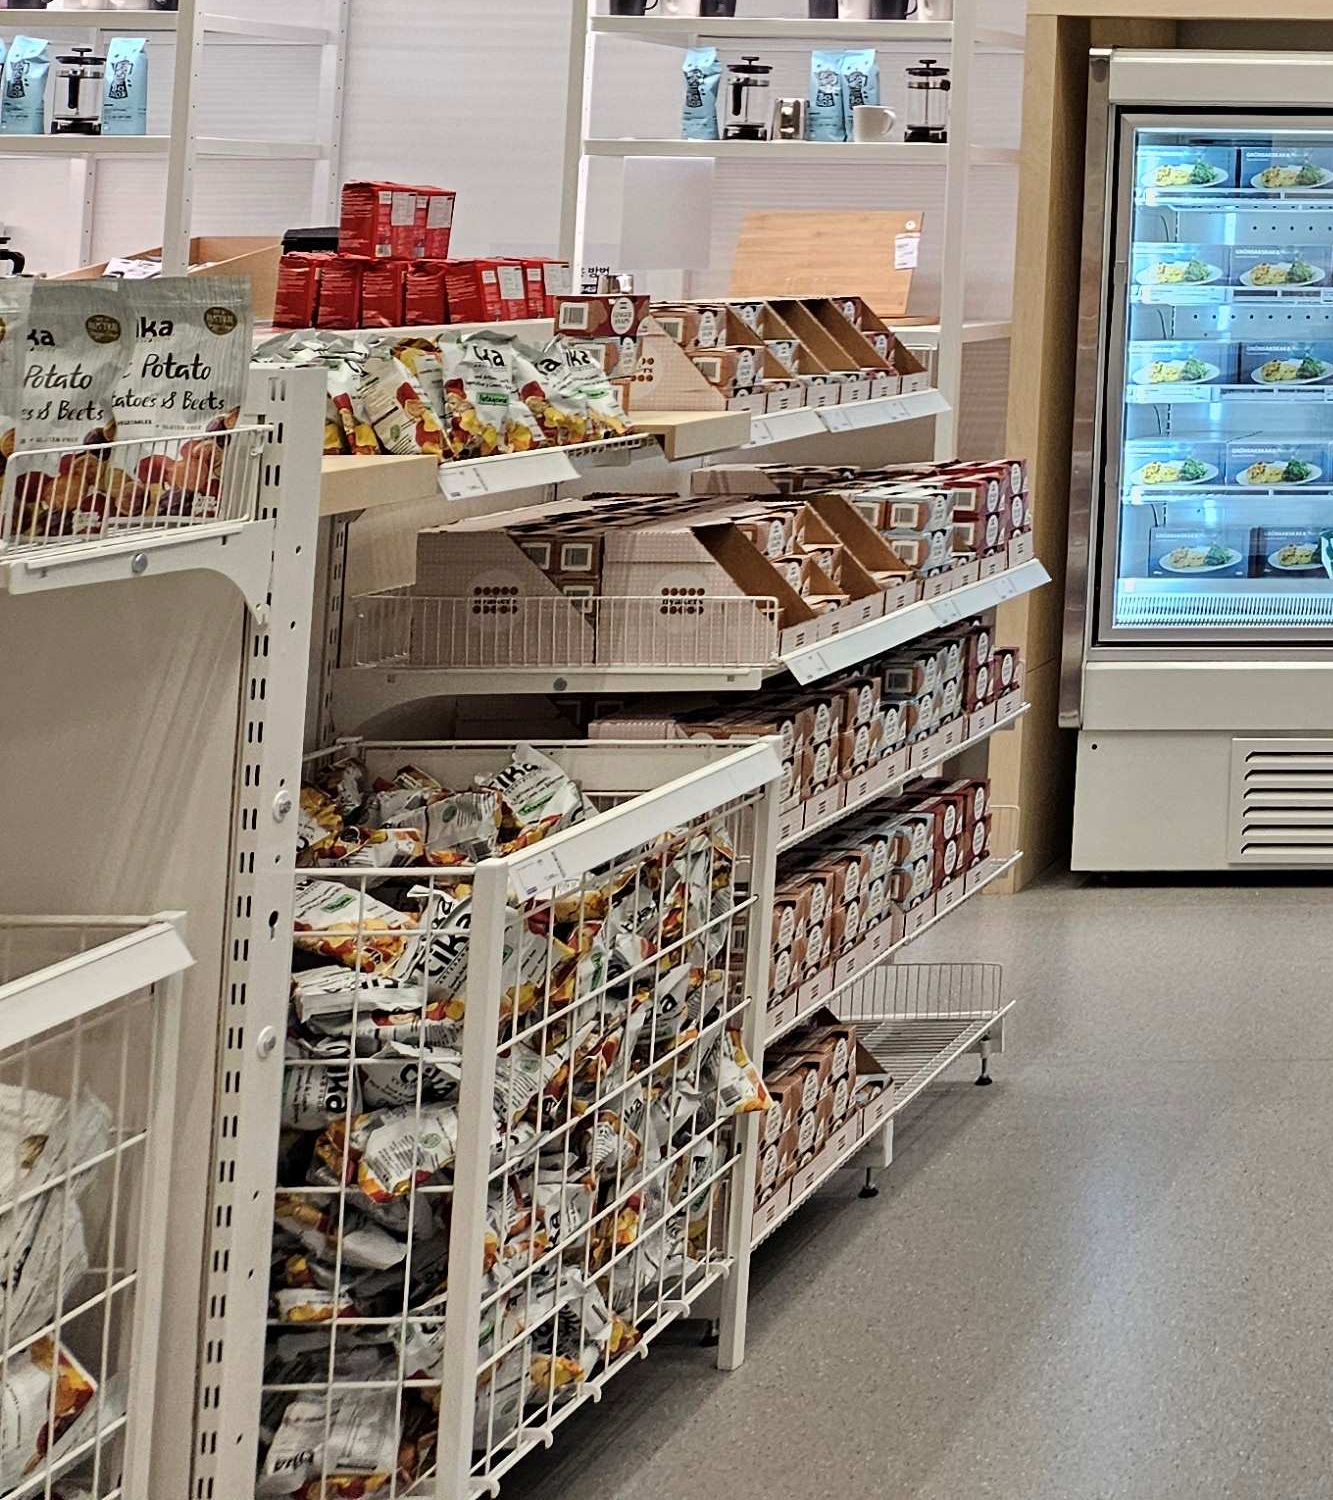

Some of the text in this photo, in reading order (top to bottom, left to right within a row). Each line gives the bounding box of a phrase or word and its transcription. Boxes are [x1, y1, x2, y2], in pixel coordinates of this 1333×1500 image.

[23, 364, 92, 390] Potato
[142, 353, 211, 380] Potato
[58, 401, 104, 421] Beets
[182, 390, 225, 411] Beets
